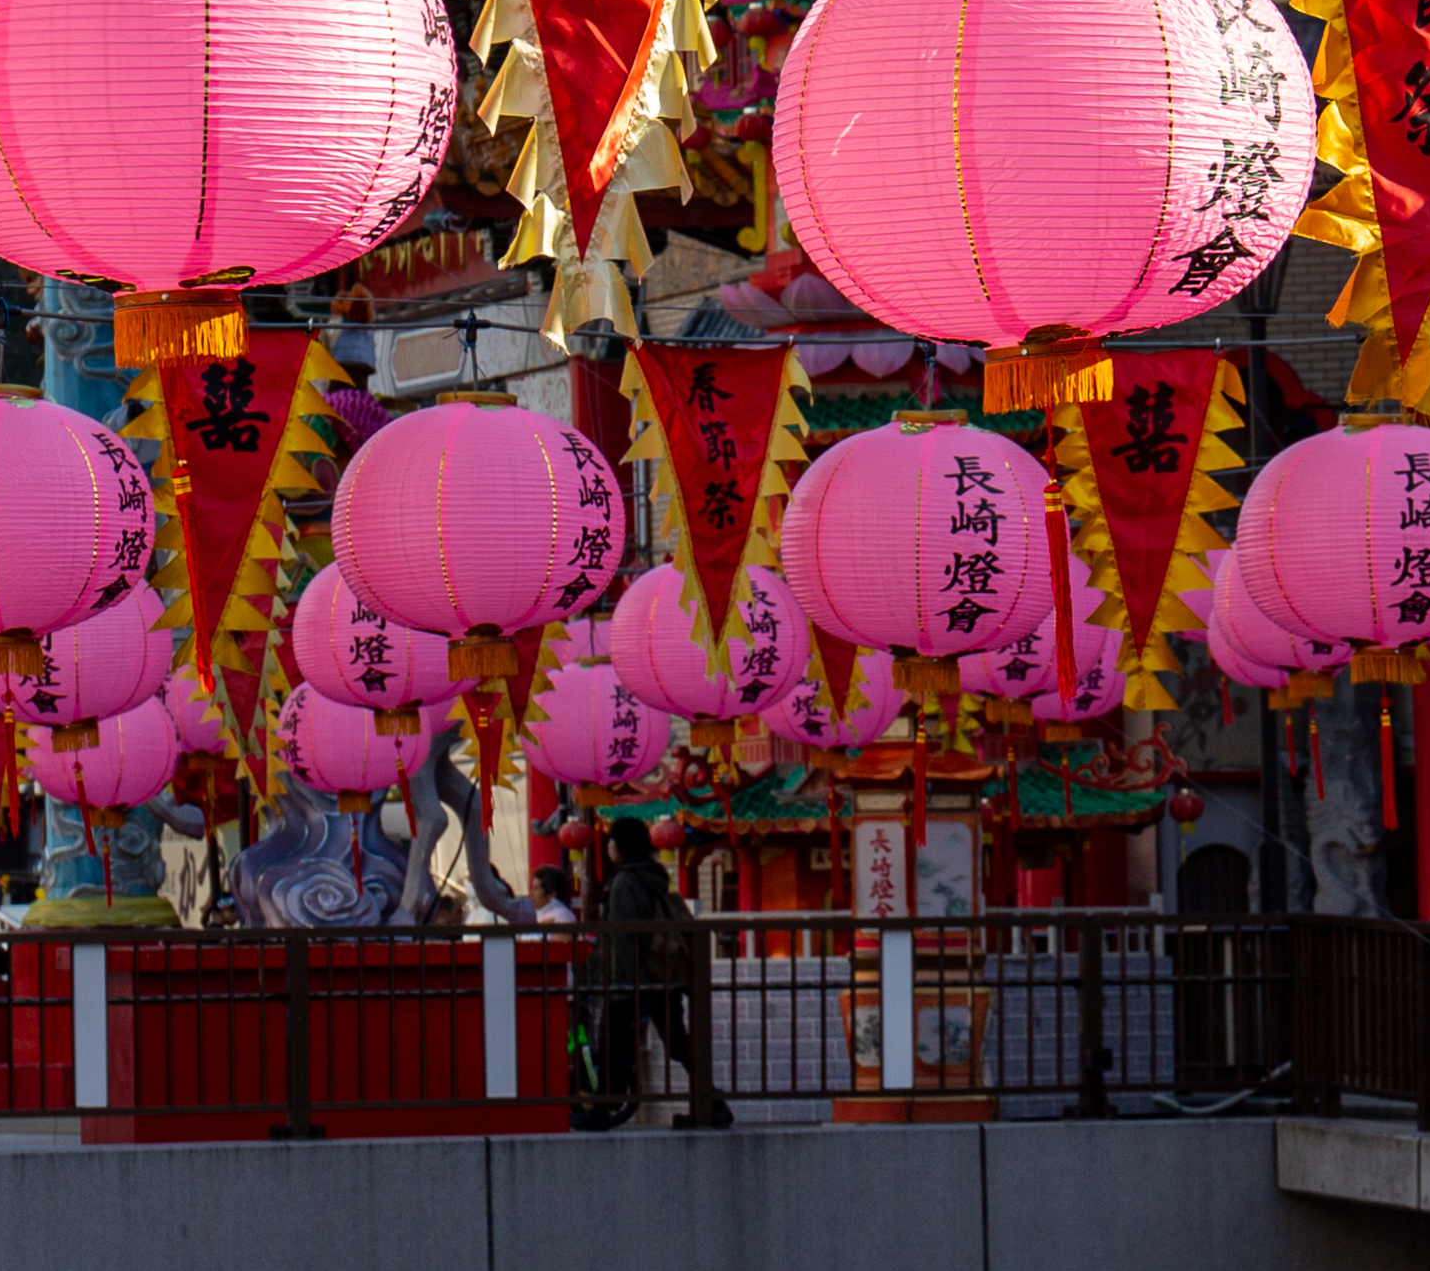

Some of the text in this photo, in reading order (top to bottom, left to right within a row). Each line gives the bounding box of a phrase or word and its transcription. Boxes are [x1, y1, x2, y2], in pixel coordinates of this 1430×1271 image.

[90, 432, 150, 611] 長崎燈會
[552, 431, 611, 611] 長崎燈會
[686, 362, 744, 529] 春節祭
[936, 455, 1007, 634] 長崎燈會
